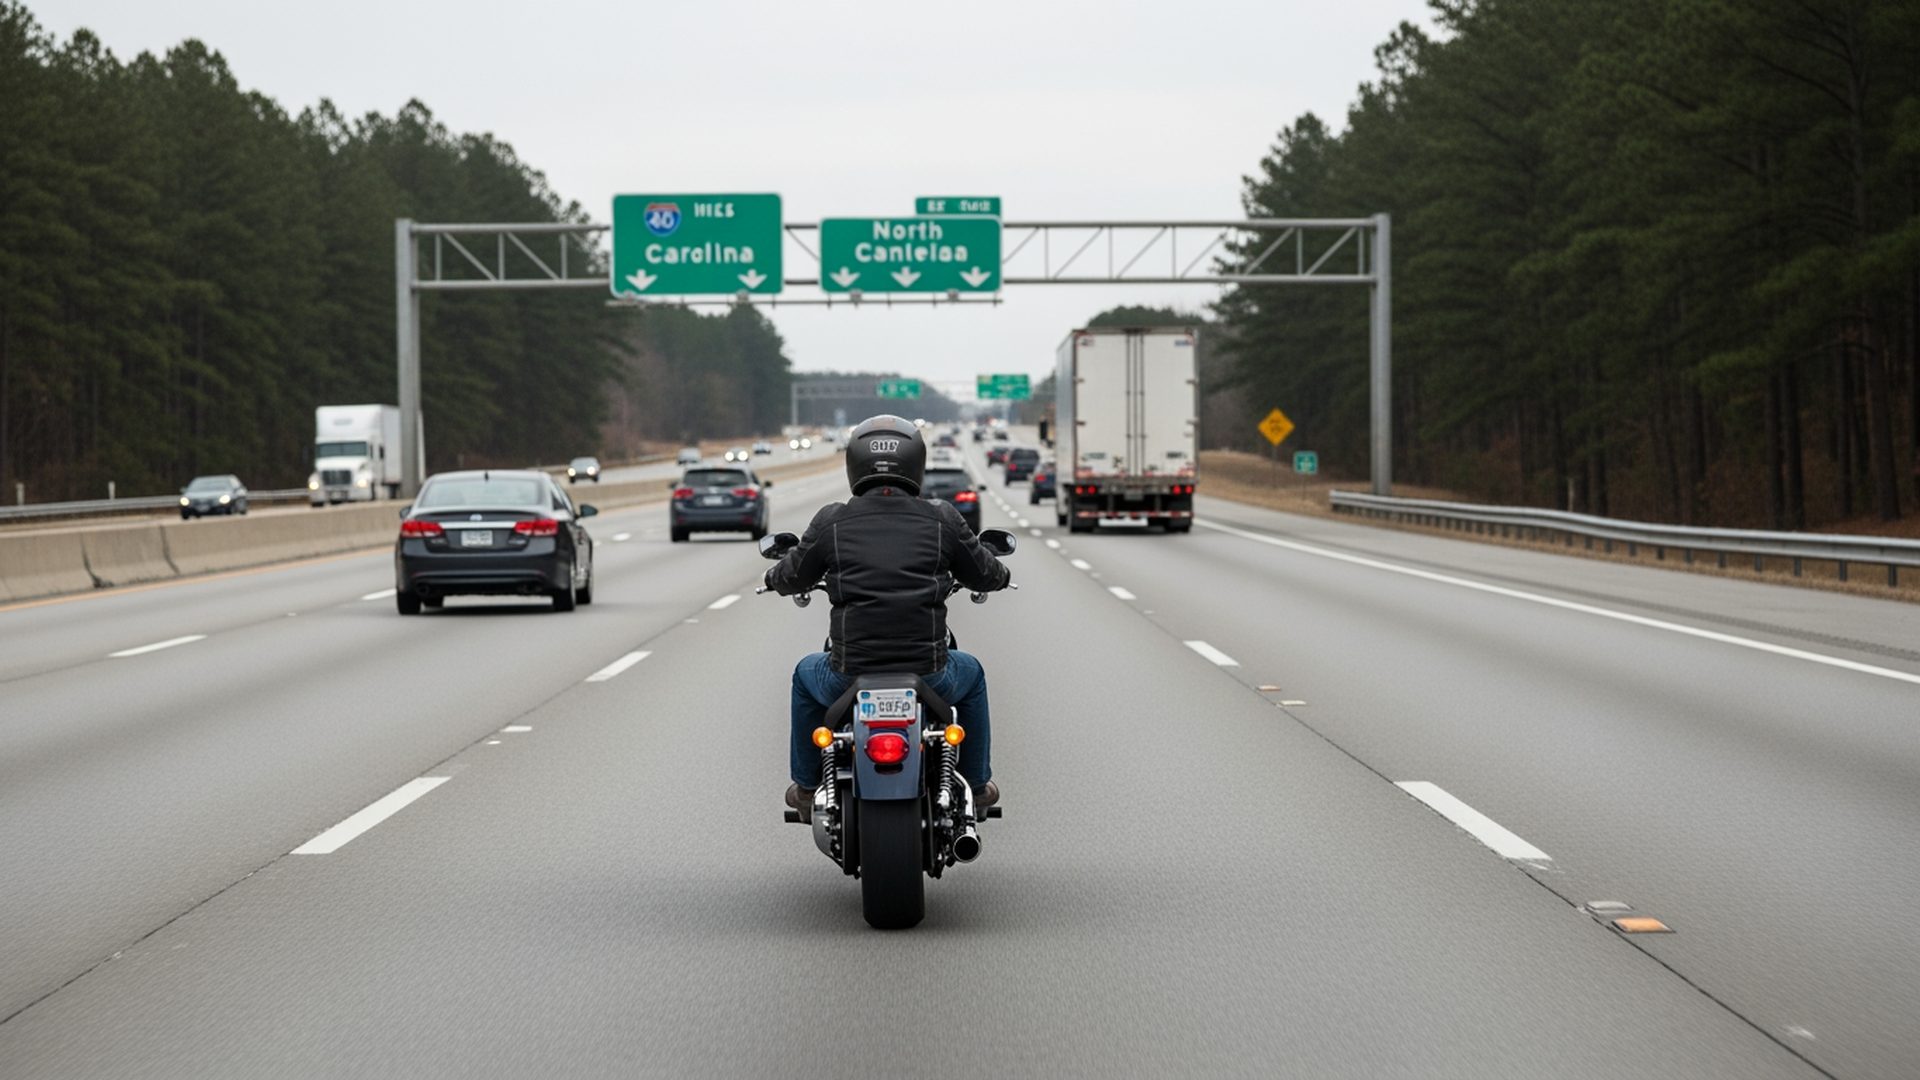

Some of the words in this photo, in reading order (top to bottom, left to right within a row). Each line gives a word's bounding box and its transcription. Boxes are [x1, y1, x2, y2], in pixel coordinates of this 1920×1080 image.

[649, 210, 675, 229] 40
[872, 220, 943, 240] North
[645, 241, 754, 264] Carolina
